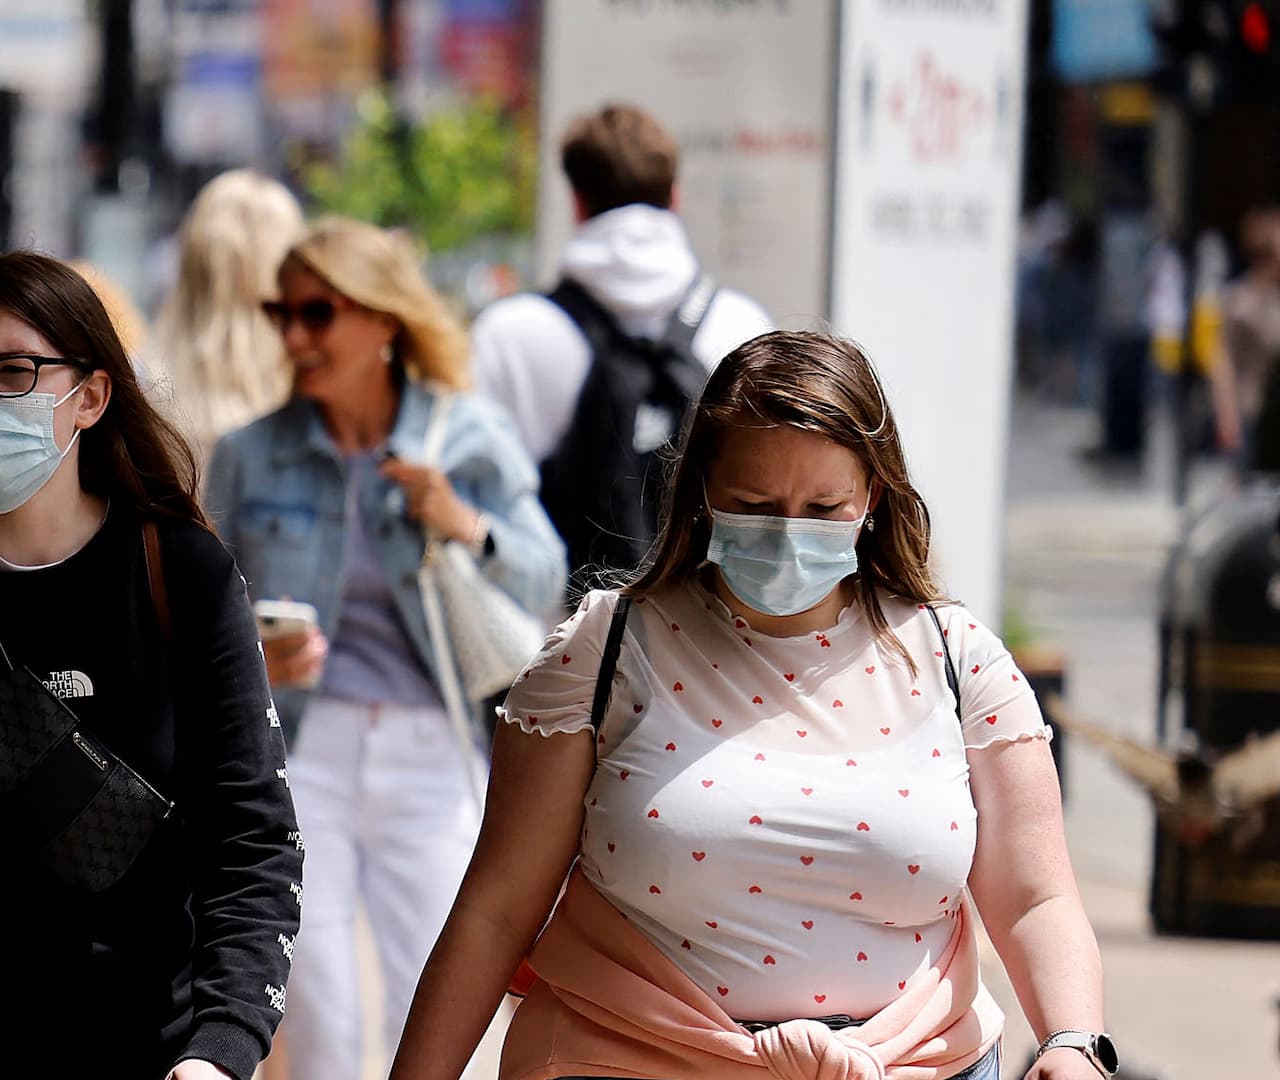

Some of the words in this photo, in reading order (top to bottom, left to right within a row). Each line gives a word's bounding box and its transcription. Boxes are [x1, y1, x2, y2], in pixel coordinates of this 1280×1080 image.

[49, 671, 72, 681] THE
[41, 680, 73, 690] ORTH
[52, 689, 74, 698] ACE
